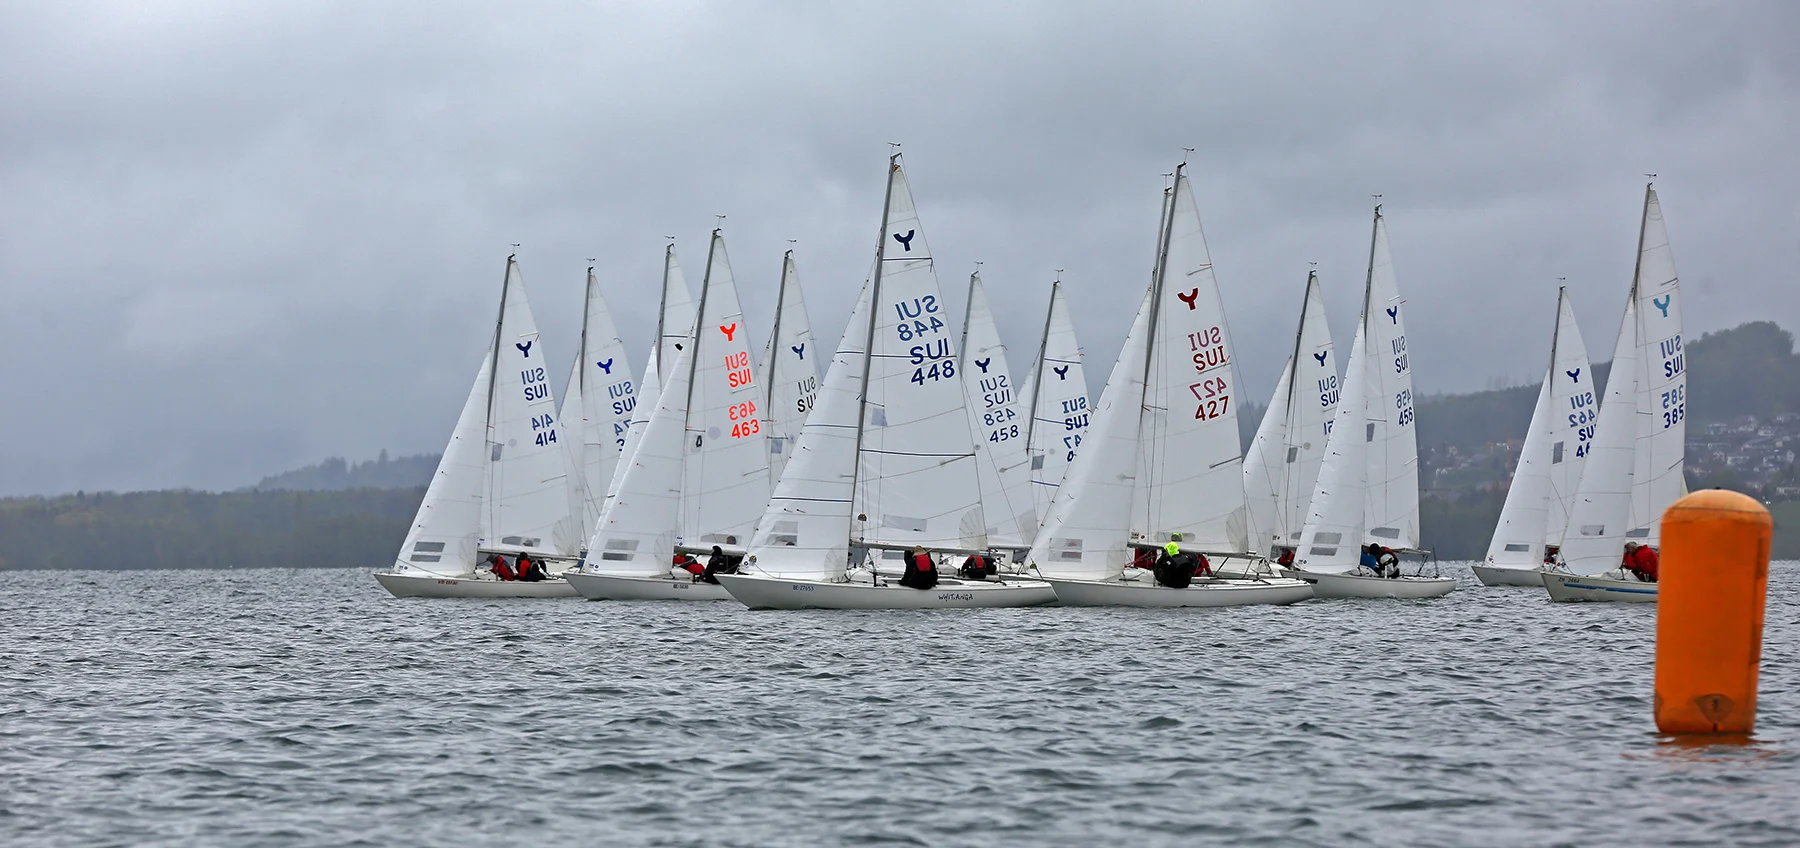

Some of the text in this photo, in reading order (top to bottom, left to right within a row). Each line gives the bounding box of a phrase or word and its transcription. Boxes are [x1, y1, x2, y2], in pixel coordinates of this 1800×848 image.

[909, 338, 949, 365] SUI
[1193, 345, 1225, 371] SUI
[910, 360, 955, 386] 448
[1395, 353, 1408, 374] SUI
[1664, 354, 1684, 378] SUI
[728, 368, 752, 388] SUI
[524, 383, 548, 401] SUI
[984, 389, 1010, 408] SUI
[1320, 390, 1339, 407] SUI
[1195, 395, 1229, 421] 427
[1398, 406, 1413, 427] 456
[1663, 403, 1685, 429] 385
[731, 419, 759, 439] 463
[1065, 413, 1089, 430] SUI
[535, 429, 557, 446] 414
[989, 424, 1019, 443] 458
[1578, 423, 1597, 442] SU
